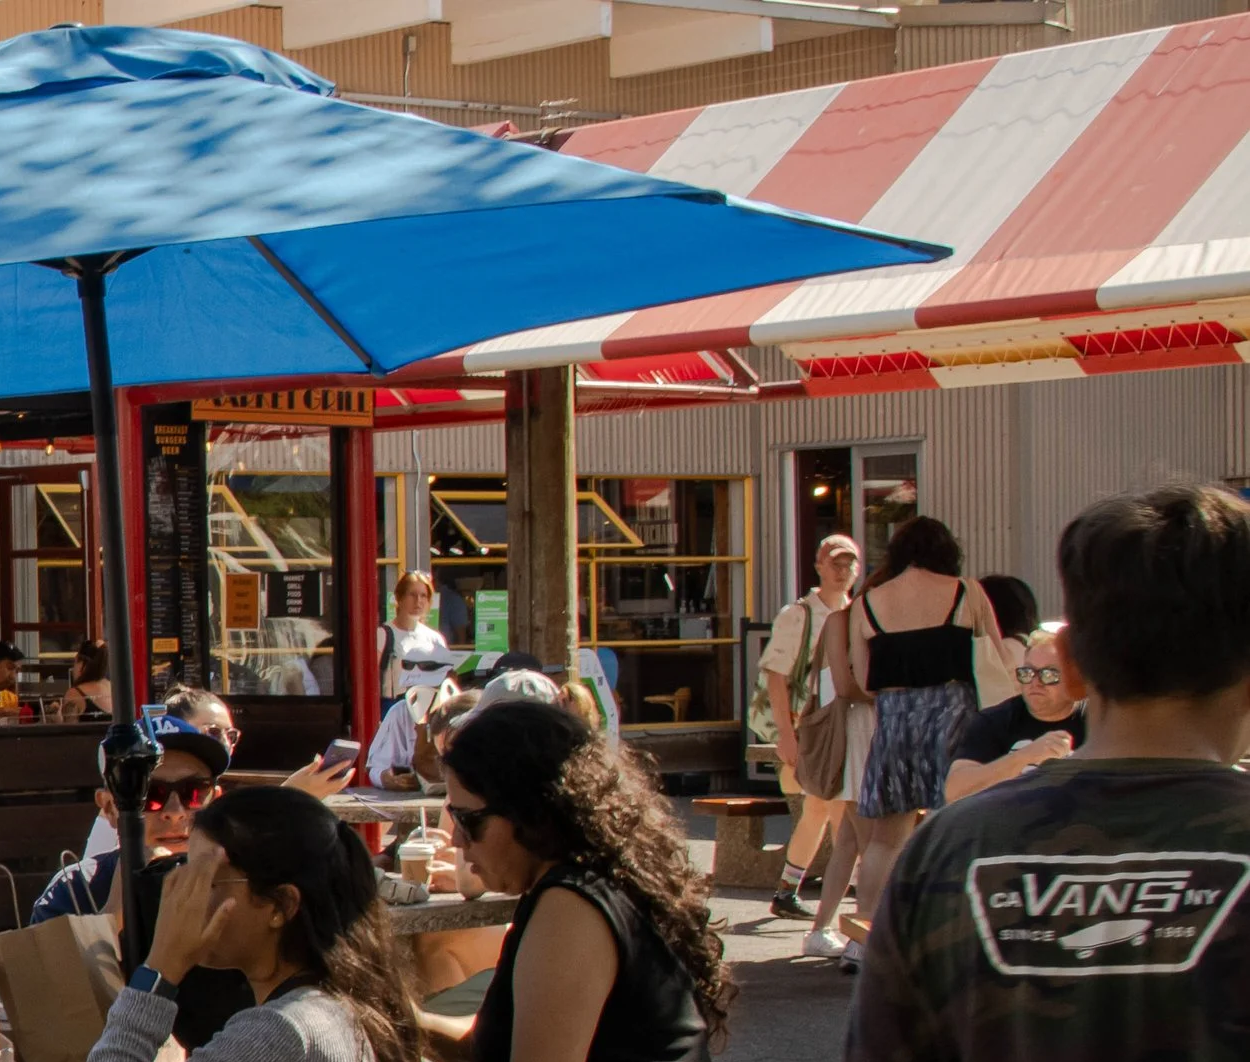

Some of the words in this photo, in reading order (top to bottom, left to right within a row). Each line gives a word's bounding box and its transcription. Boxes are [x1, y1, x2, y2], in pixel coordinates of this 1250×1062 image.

[303, 388, 370, 413] GRILL
[151, 716, 179, 734] LA
[989, 891, 1023, 908] CA
[1022, 870, 1193, 916] VANS
[1183, 889, 1223, 906] NY
[998, 929, 1055, 942] SINCE
